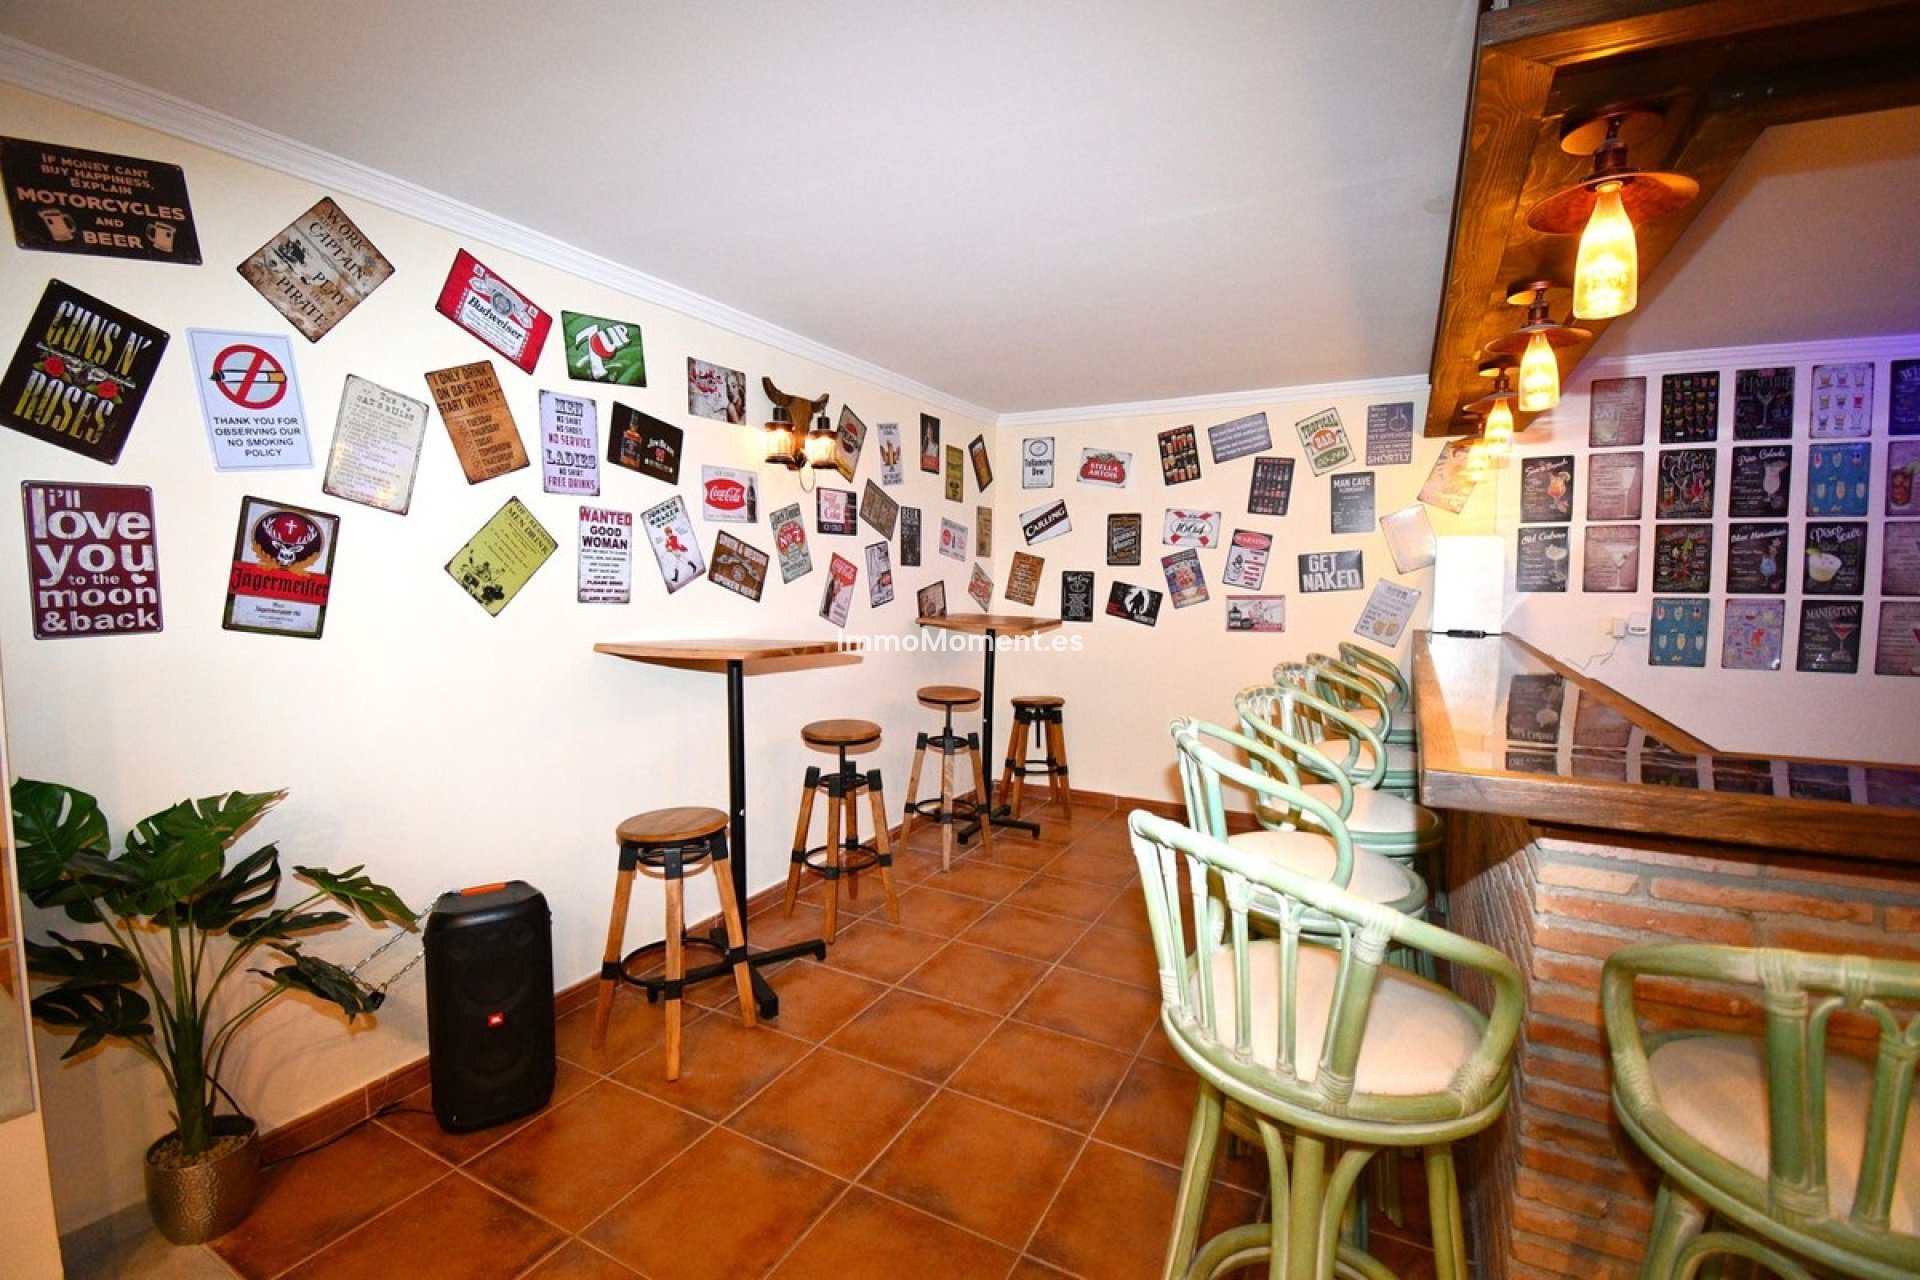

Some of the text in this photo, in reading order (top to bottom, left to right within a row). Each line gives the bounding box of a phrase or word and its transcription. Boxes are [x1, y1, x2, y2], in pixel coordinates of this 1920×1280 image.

[41, 153, 55, 164] IF
[62, 157, 110, 172] MONEY
[41, 164, 69, 177] BUY
[70, 178, 132, 195] EXPLAIN
[16, 187, 186, 221] MOTORCYCLES
[95, 217, 124, 228] AND
[327, 209, 367, 251] WORK
[84, 232, 143, 249] BEER
[309, 222, 364, 280] CAPTAIN
[276, 276, 329, 327] PIRATE
[468, 295, 522, 341] Budweiser
[45, 300, 121, 366] GUNS
[439, 372, 460, 385] ONLY
[463, 366, 487, 378] DRINK
[436, 378, 494, 399] ON DAYS THAT
[13, 370, 115, 445] ROSES
[437, 399, 463, 414] START
[464, 394, 486, 408] WITH
[213, 416, 299, 425] THANK YOU FOR
[214, 427, 301, 436] OBSERVING OUR
[548, 432, 591, 448] NO SERVICE
[227, 438, 294, 447] NO SMOKING
[244, 448, 282, 458] POLICY
[1089, 462, 1118, 472] STELLA
[548, 476, 567, 488] FREE
[1333, 476, 1372, 488] MAN CAVE
[31, 488, 151, 540] love
[579, 506, 633, 526] WANTED
[590, 525, 622, 537] GOOD
[582, 536, 628, 550] WOMAN
[35, 543, 155, 586] you
[1308, 553, 1338, 572] GET
[68, 573, 121, 585] to the
[1302, 569, 1362, 591] NAKED
[39, 586, 157, 608] moon
[1805, 605, 1858, 618] MANHATTAN
